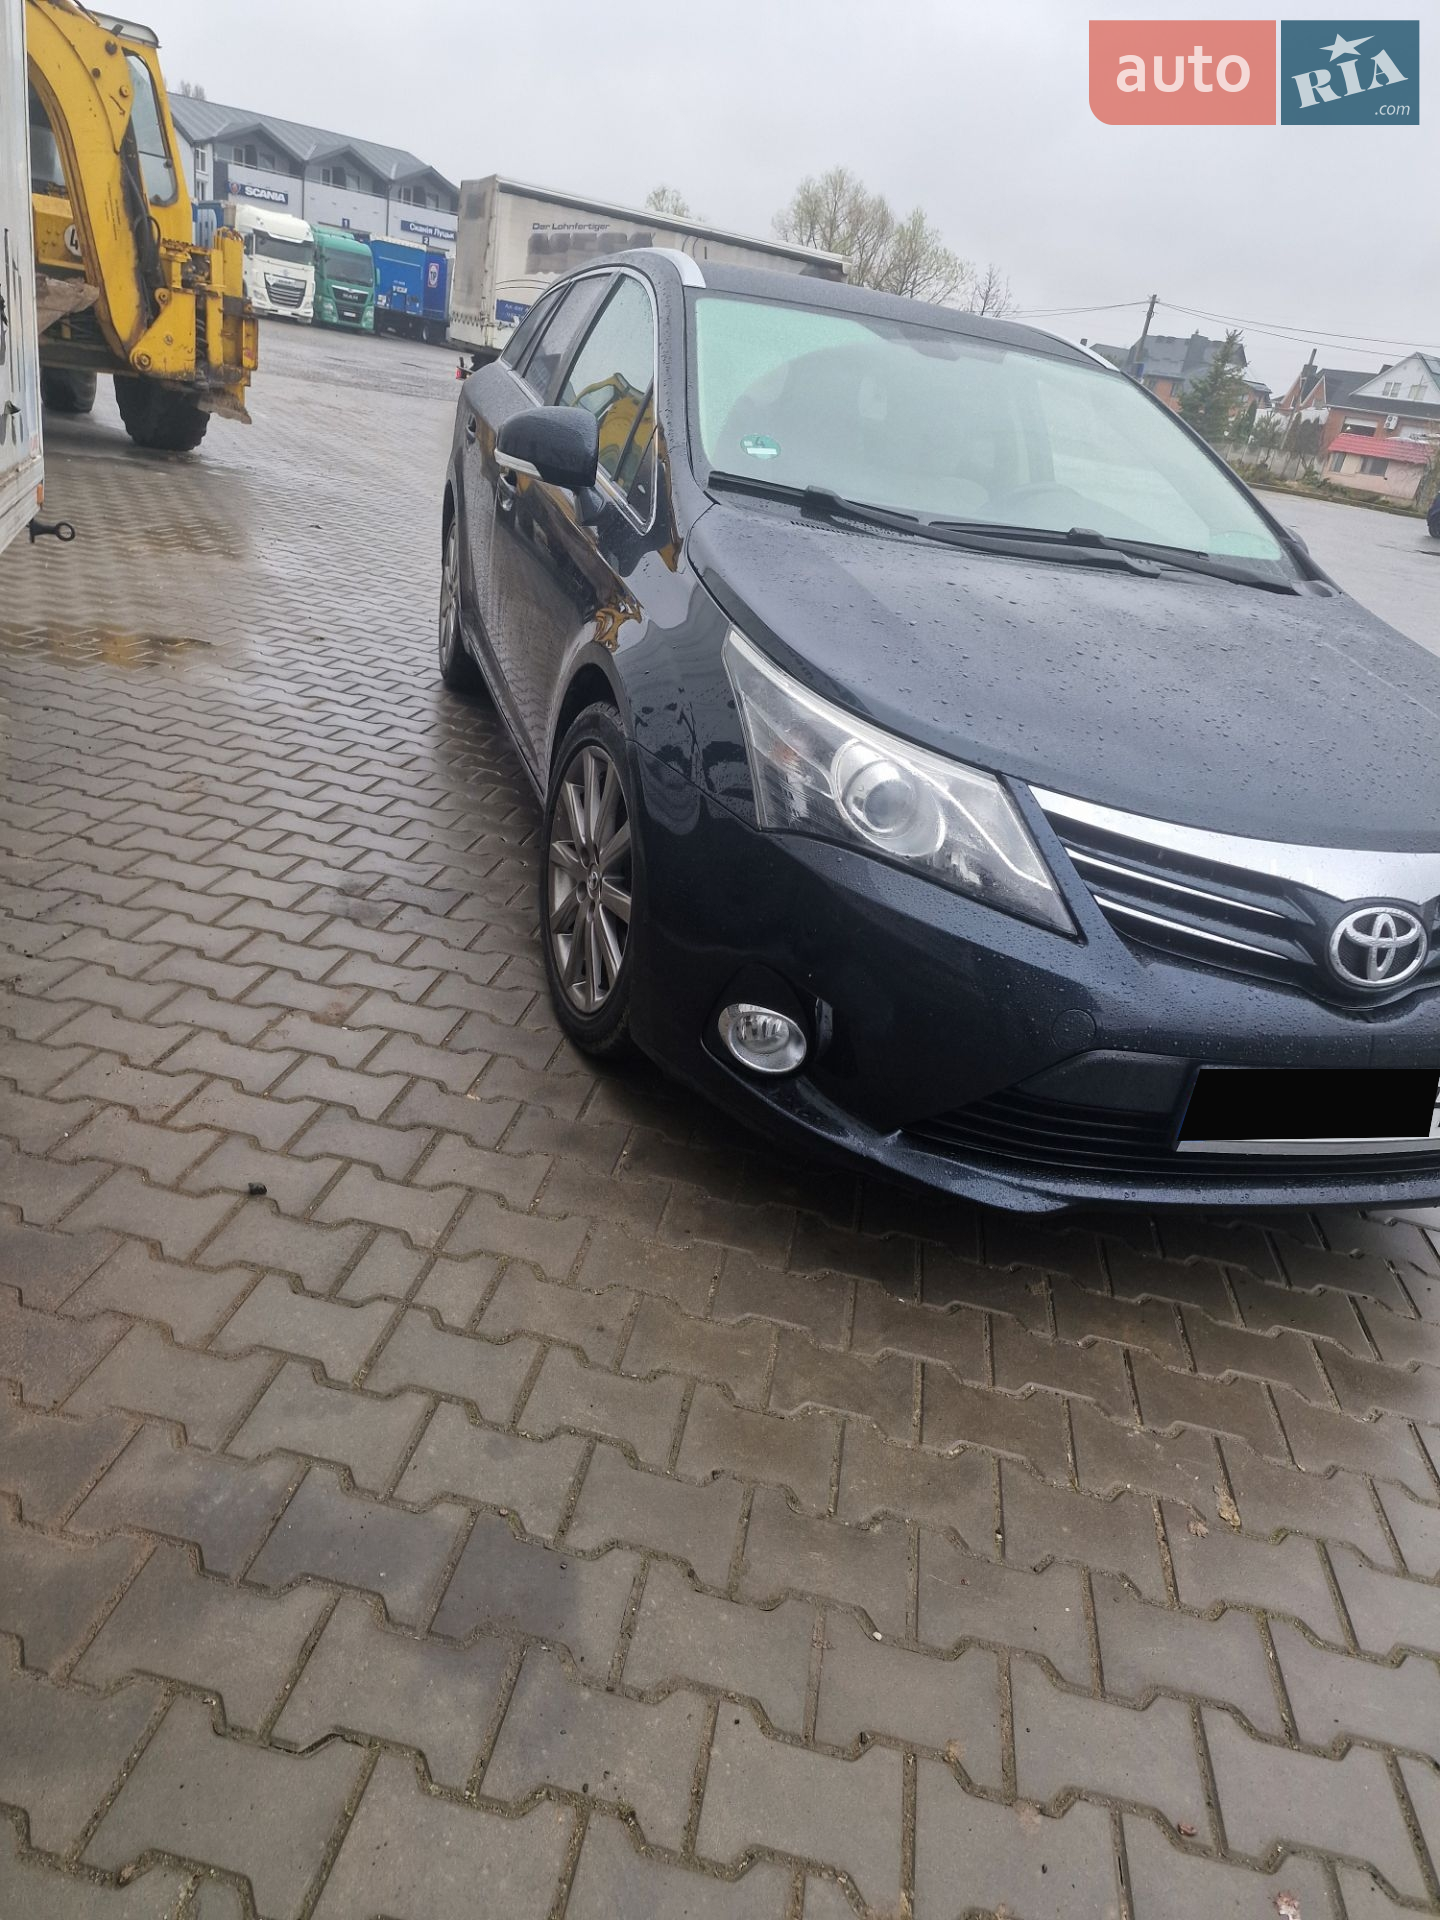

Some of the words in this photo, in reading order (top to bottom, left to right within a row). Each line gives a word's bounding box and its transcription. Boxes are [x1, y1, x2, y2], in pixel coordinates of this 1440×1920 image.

[244, 186, 286, 202] SCANIA
[409, 223, 433, 236] Сканія
[433, 228, 455, 240] Луцьк
[532, 222, 550, 230] Der
[551, 222, 611, 232] Lohnfertiger
